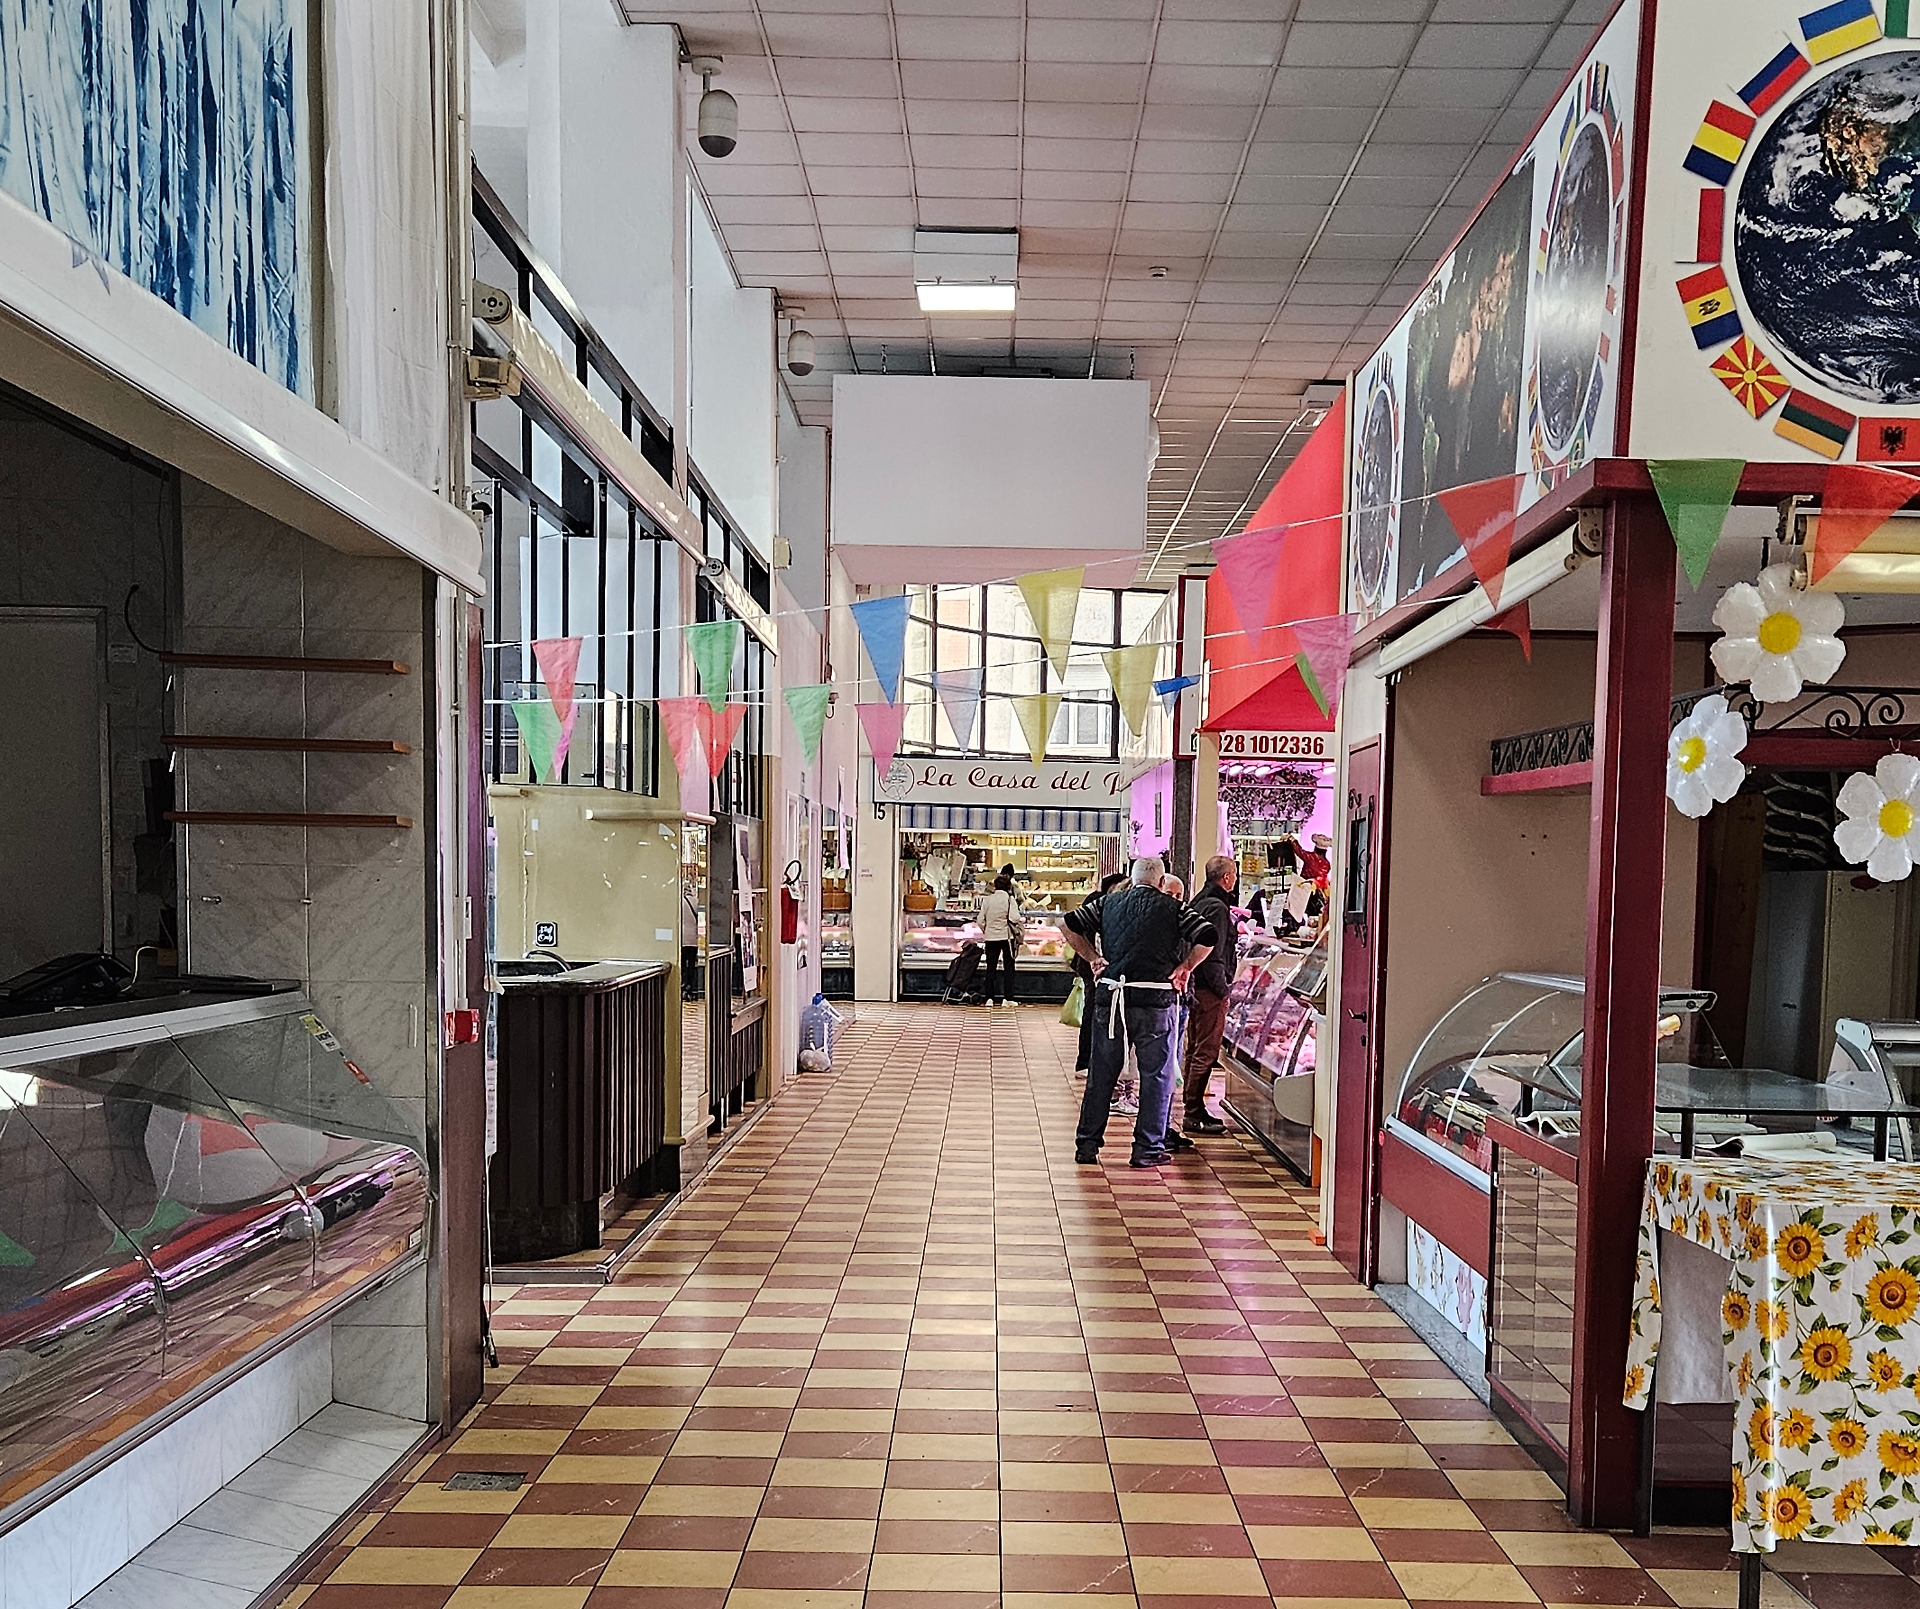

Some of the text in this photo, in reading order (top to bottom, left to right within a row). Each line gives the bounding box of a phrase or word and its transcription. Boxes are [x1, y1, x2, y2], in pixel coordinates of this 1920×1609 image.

[1250, 735, 1325, 756] 1012336
[917, 765, 957, 787] La
[967, 766, 1040, 789] Casa
[1050, 769, 1092, 791] del
[873, 803, 886, 821] 15
